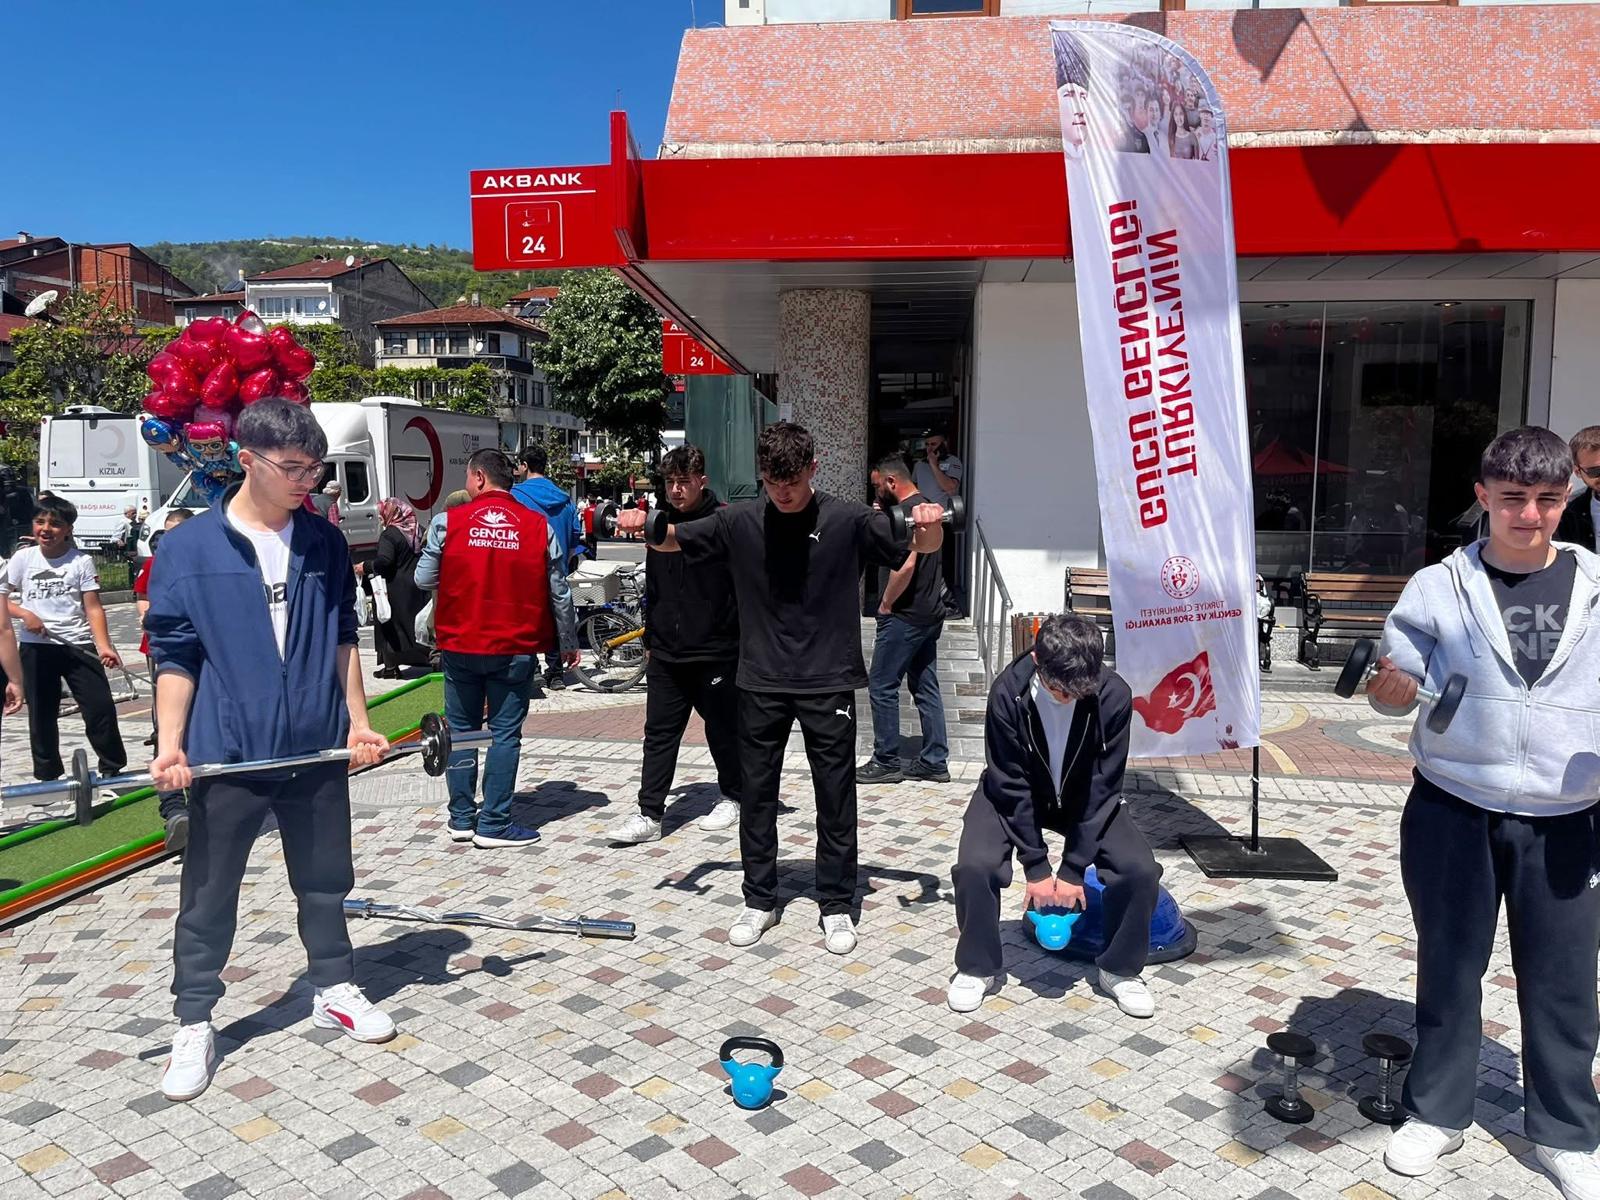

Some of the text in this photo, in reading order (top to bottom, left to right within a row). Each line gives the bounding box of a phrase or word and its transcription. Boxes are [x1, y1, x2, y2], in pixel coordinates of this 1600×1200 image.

[482, 172, 582, 189] AKBANK
[522, 236, 546, 254] 24
[690, 356, 704, 367] 24
[99, 467, 126, 475] KIZILAY
[469, 527, 520, 541] GENÇLİK
[468, 538, 520, 550] MERKEZLERİ
[1502, 604, 1562, 632] CK
[1509, 632, 1561, 661] NE
